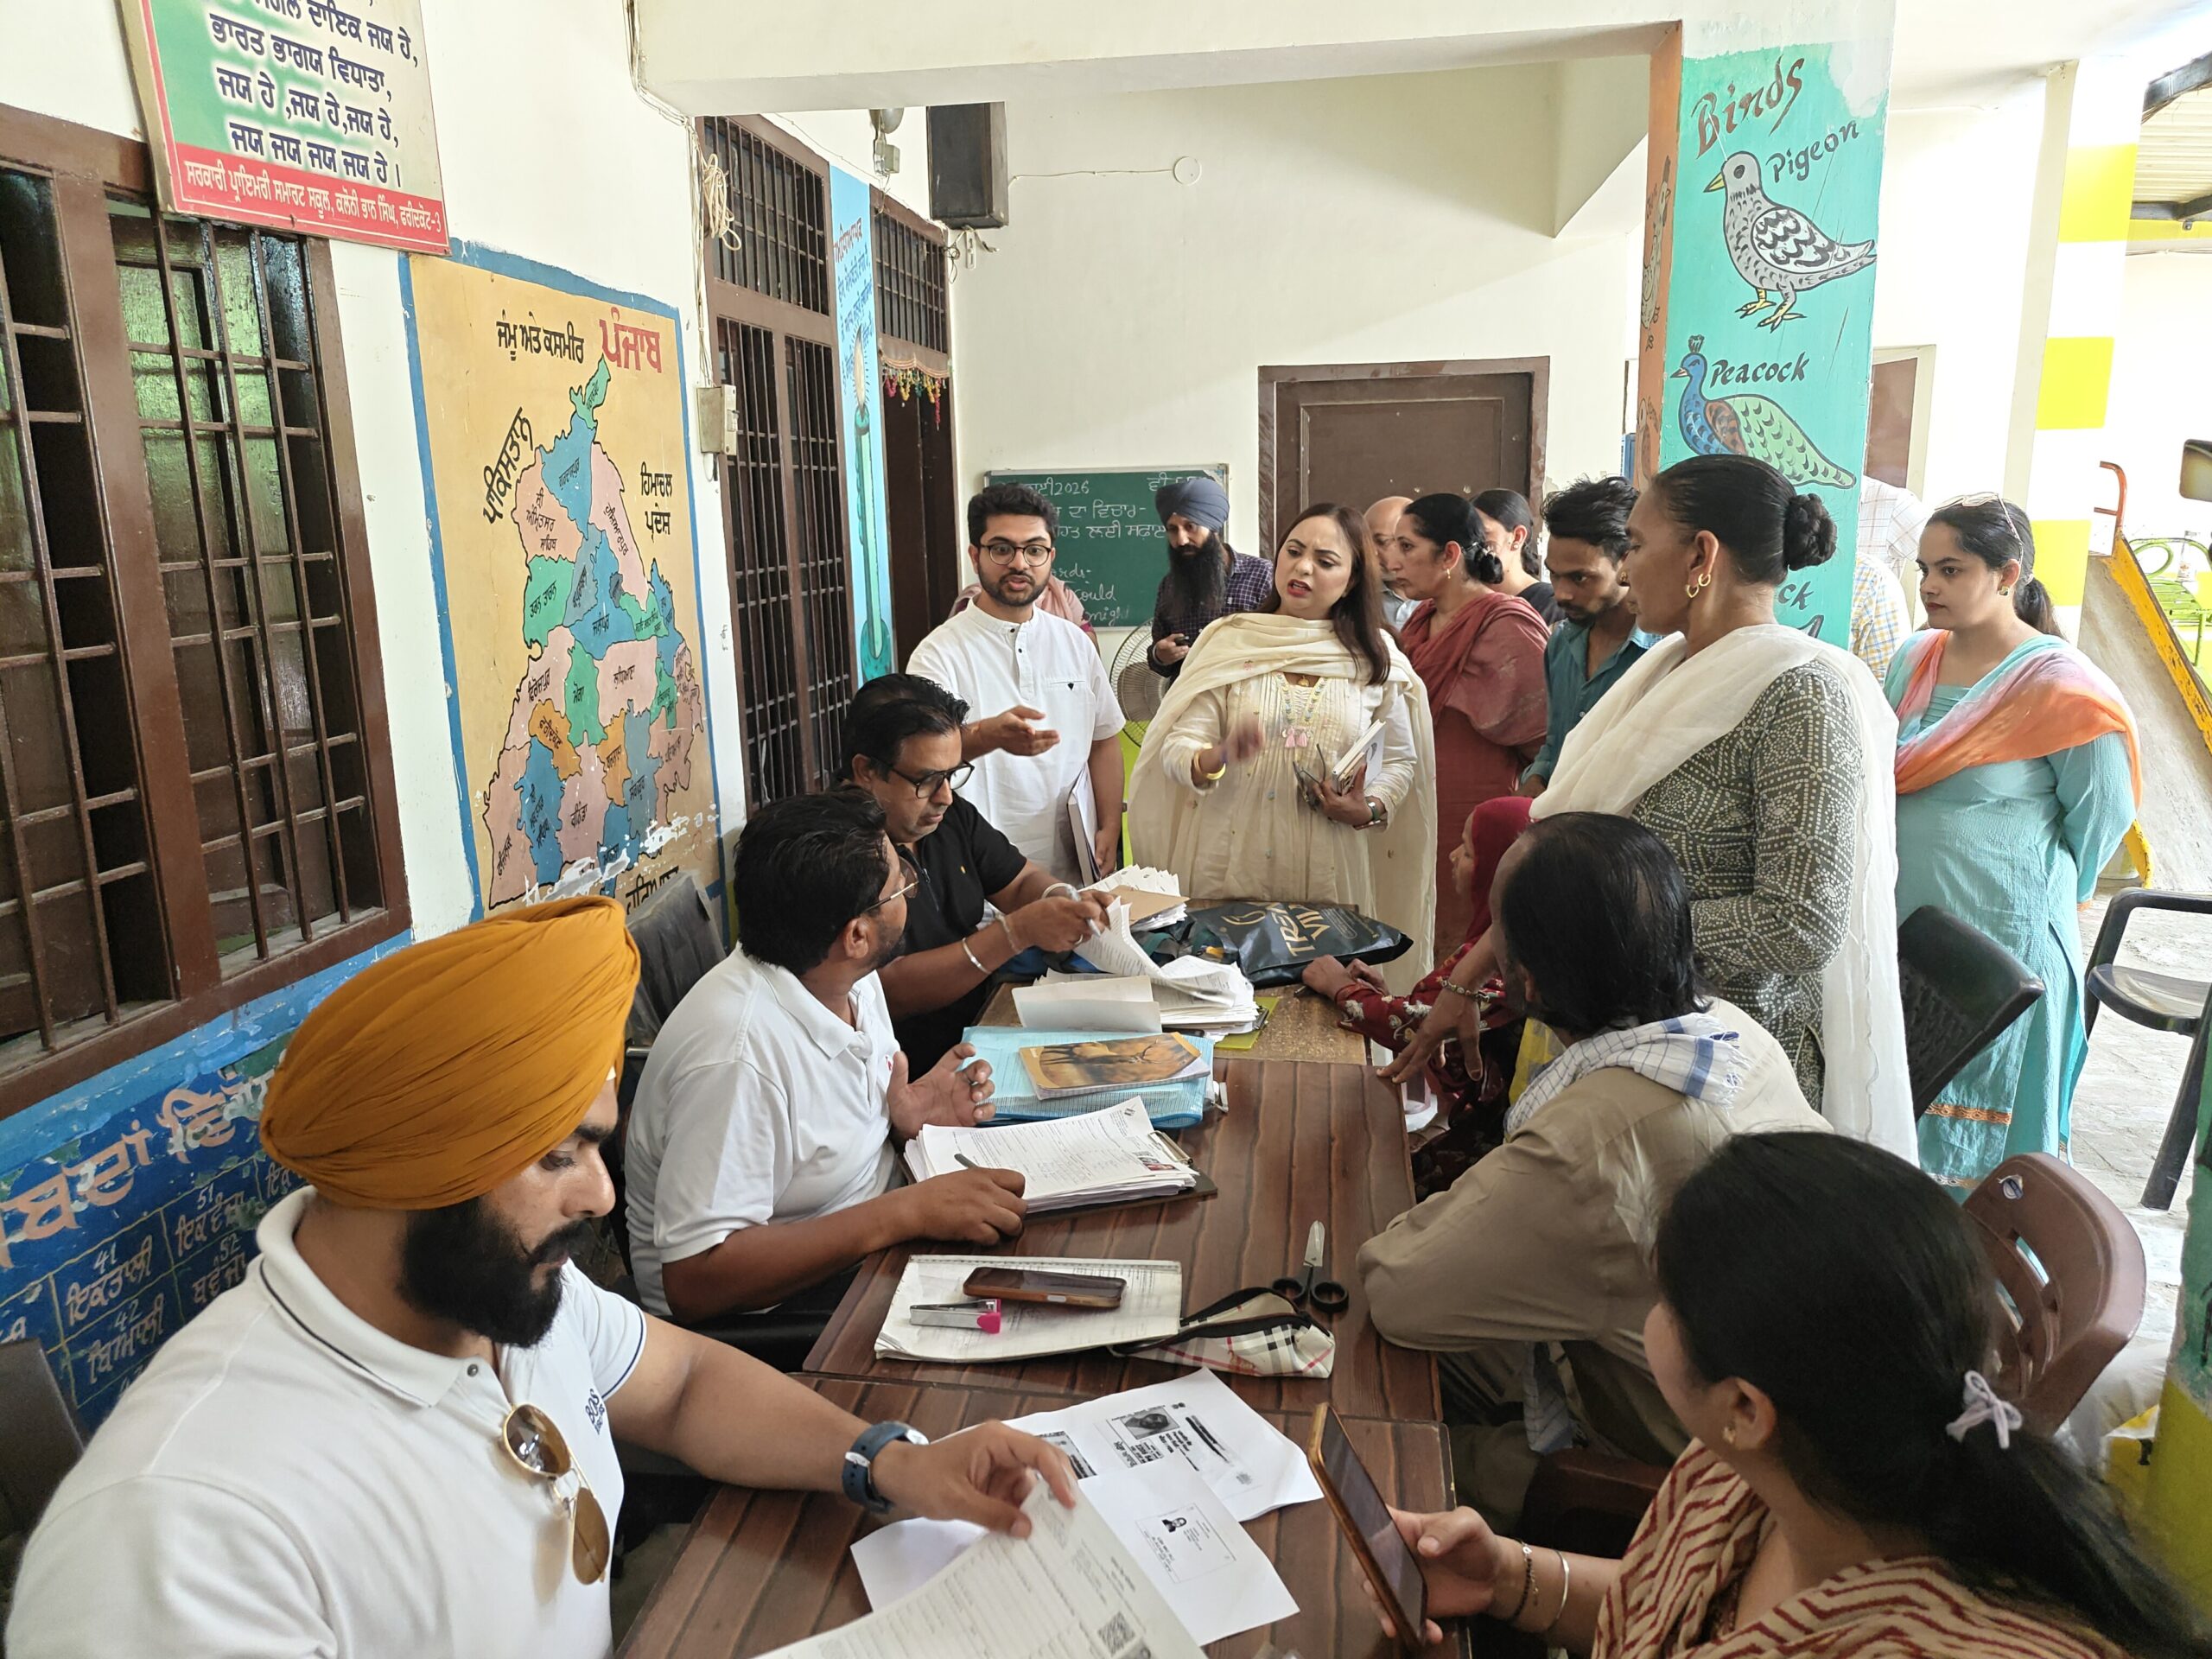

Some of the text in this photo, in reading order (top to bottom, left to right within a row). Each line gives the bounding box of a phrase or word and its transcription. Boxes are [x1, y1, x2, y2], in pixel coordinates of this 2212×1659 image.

[209, 13, 264, 55] ਭਾਰਤ
[270, 34, 324, 76] ਭਾਗਯ
[366, 22, 394, 54] ਜਯ
[216, 67, 252, 103] ਜਯ
[257, 71, 275, 108] ਹੇ
[229, 122, 264, 156] ਜਯ
[270, 132, 302, 165] ਜਯ
[307, 142, 337, 173] ਜਯ
[341, 150, 370, 180] ਜਯ
[1765, 120, 1859, 182] Pigeon
[183, 159, 227, 192] ਸਰਕਾਰੀ
[228, 164, 271, 203] ਪ੍ਰਾਇਮਰੀ
[272, 179, 306, 207] ਸਮਾਰਟ
[519, 311, 541, 353] ਅਤੇ
[599, 307, 662, 373] ਪੰਜਾਬ
[1710, 351, 1809, 388] Peacock
[483, 406, 534, 524] ਪਾਕਿਸਤਾਨ
[640, 461, 673, 497] ਹਿਮਾਚਲ
[1069, 506, 1086, 518] ਦਾ
[1086, 519, 1121, 538] ਲਈ
[0, 1119, 153, 1268] ਬਦਾਂ
[197, 1182, 213, 1210] 51
[93, 1242, 118, 1274] 41
[220, 1233, 242, 1262] 52
[114, 1299, 143, 1332] 42
